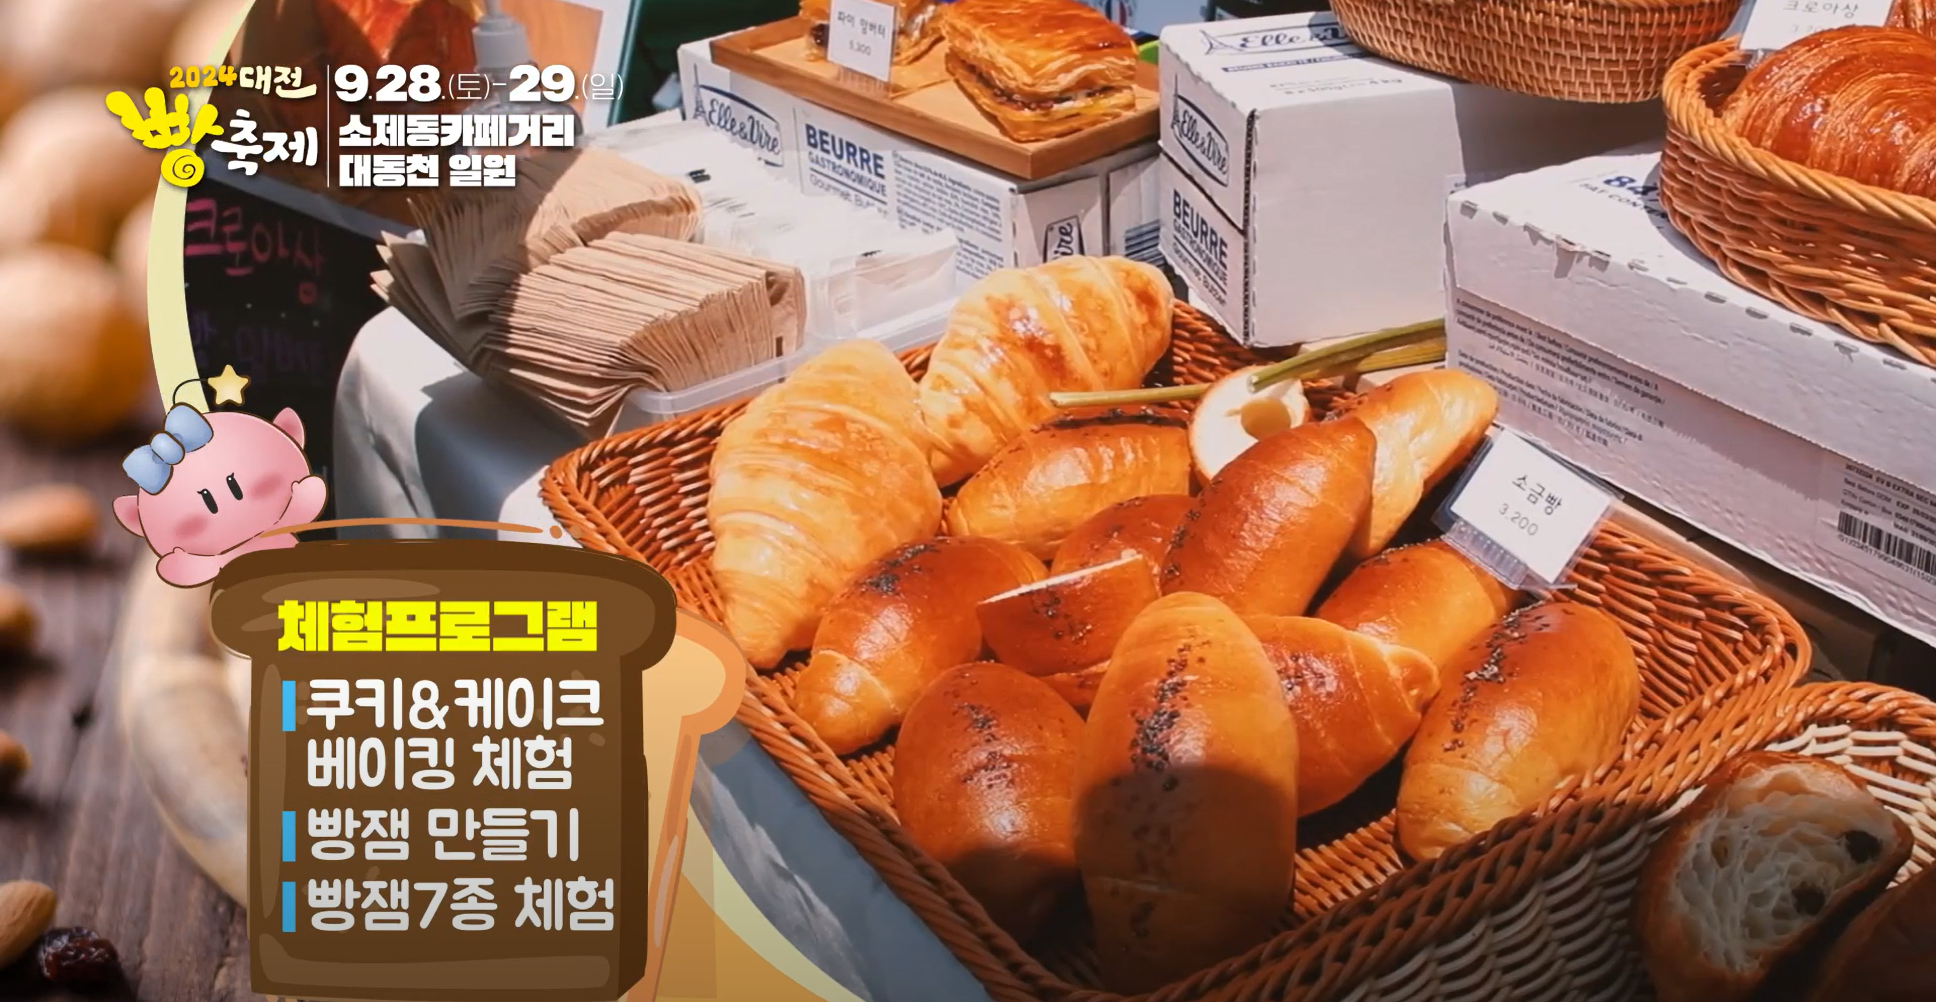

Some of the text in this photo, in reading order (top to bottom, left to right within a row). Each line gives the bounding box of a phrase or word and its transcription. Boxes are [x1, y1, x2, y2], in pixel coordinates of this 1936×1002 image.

[805, 123, 887, 181] BEURRE
[808, 150, 889, 198] GASTRONOMIQUE
[1172, 188, 1229, 271] BEURRE
[1511, 474, 1563, 516] 소금빵
